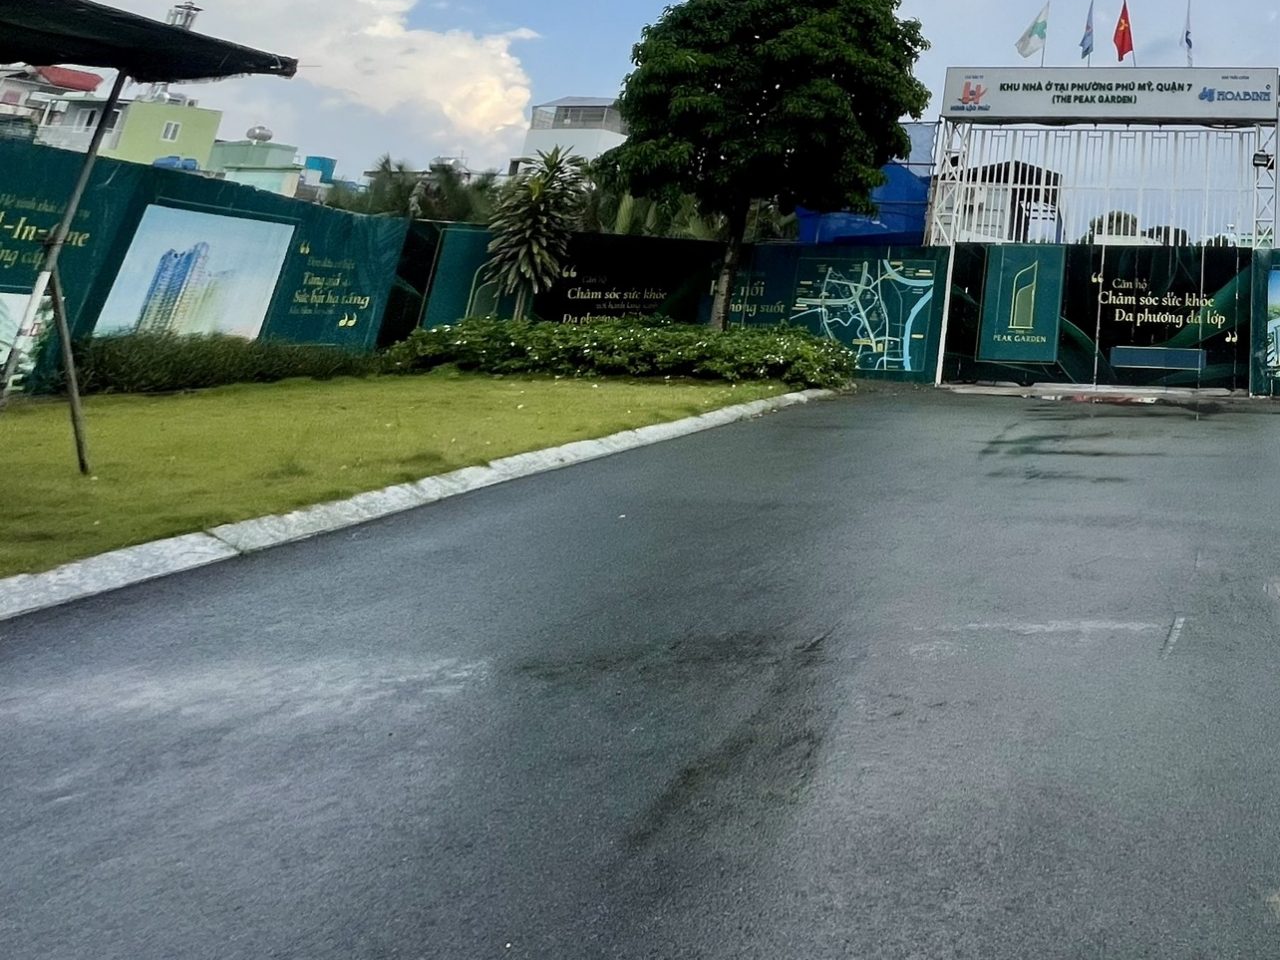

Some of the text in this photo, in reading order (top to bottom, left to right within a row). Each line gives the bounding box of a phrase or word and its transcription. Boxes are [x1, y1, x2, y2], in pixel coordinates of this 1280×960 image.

[1000, 82, 1019, 91] KHU
[1022, 80, 1042, 91] NHÀ
[1045, 80, 1053, 91] Ở
[1054, 82, 1069, 93] TẠI
[1071, 80, 1113, 91] PHƯỜNG
[1115, 81, 1136, 91] PHÚ
[1156, 81, 1185, 94] QUẬN
[1186, 83, 1193, 92] 7
[1052, 94, 1137, 105] (THE PEAK GARDEN)
[1216, 91, 1271, 102] HOABINH
[1112, 278, 1148, 290] Căn hộ
[604, 286, 622, 300] sóc
[1098, 290, 1216, 307] Chăm sóc sức khỏe
[1114, 308, 1134, 322] Đa
[1136, 309, 1184, 328] phương
[1206, 310, 1226, 328] lớp
[993, 334, 1047, 343] PEAK GARDEN
